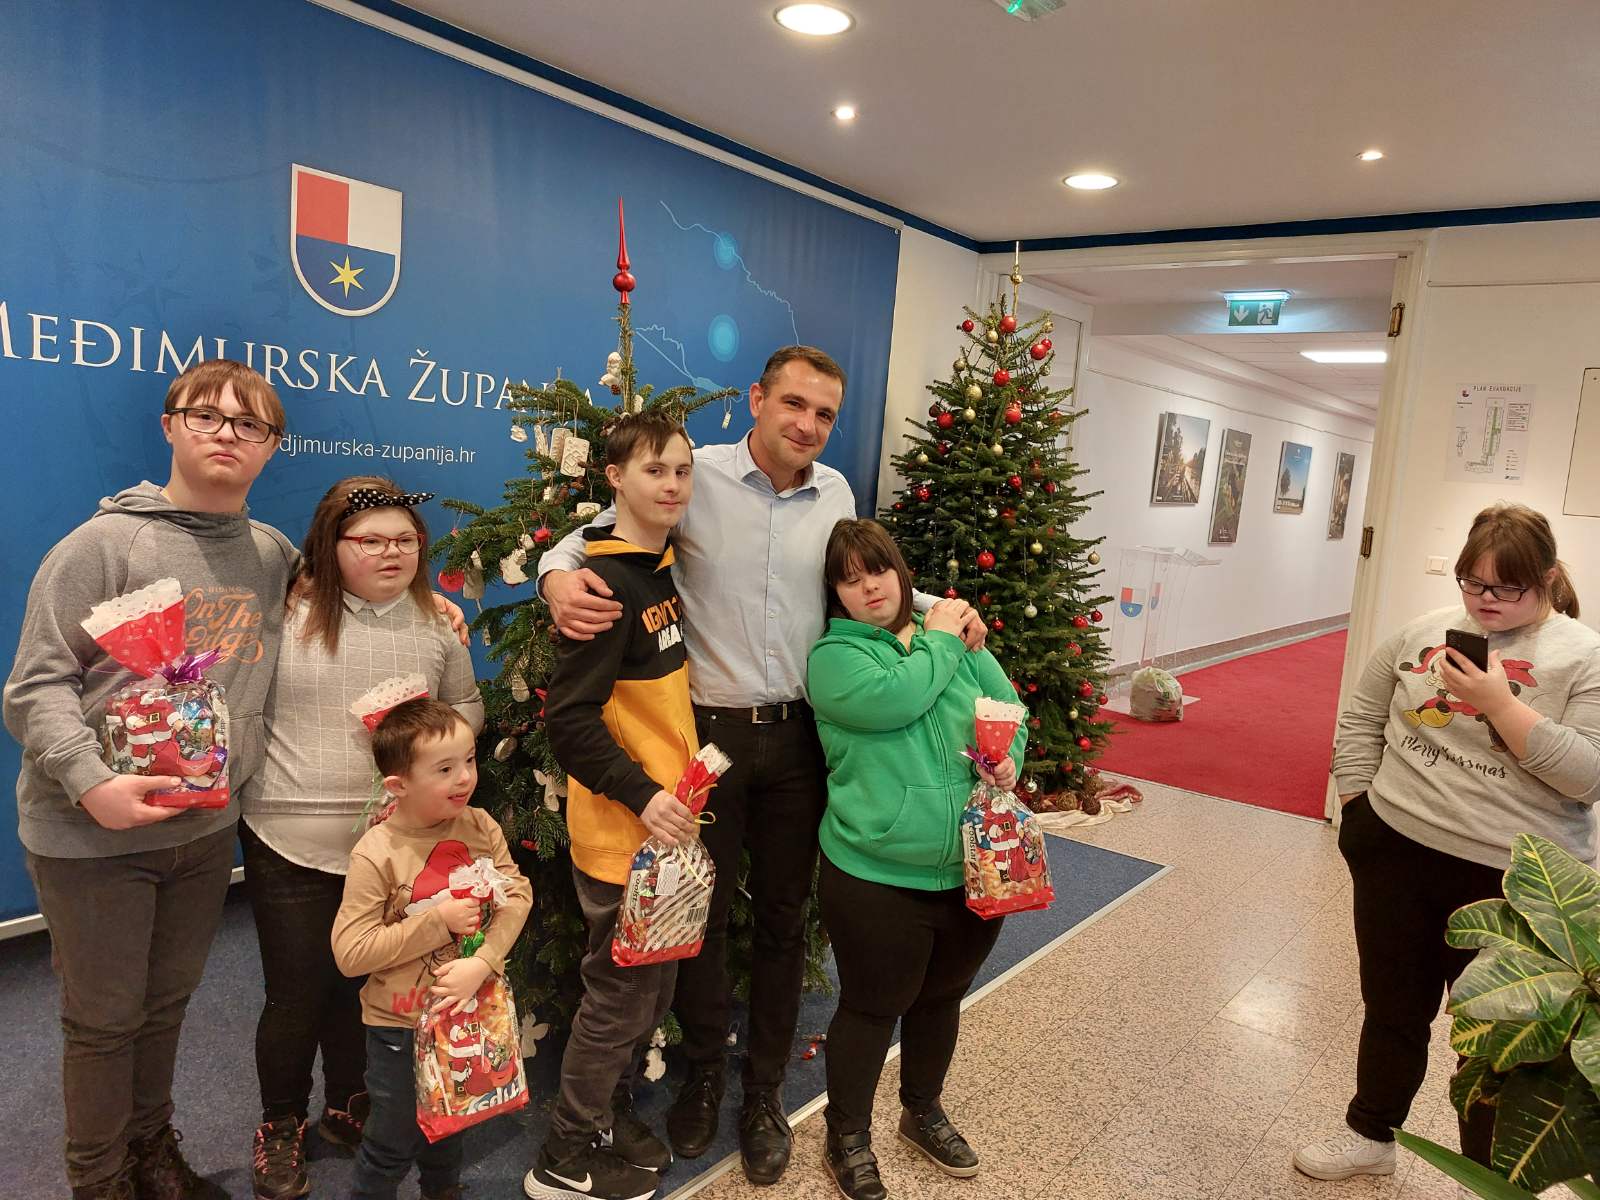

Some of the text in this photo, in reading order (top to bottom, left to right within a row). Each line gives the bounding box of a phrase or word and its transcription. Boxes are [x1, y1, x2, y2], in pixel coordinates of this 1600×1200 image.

[408, 349, 593, 415] ŽUPA
[279, 434, 476, 465] djimurska-zupanija.hr
[208, 593, 263, 629] The
[1400, 735, 1440, 768] Merry
